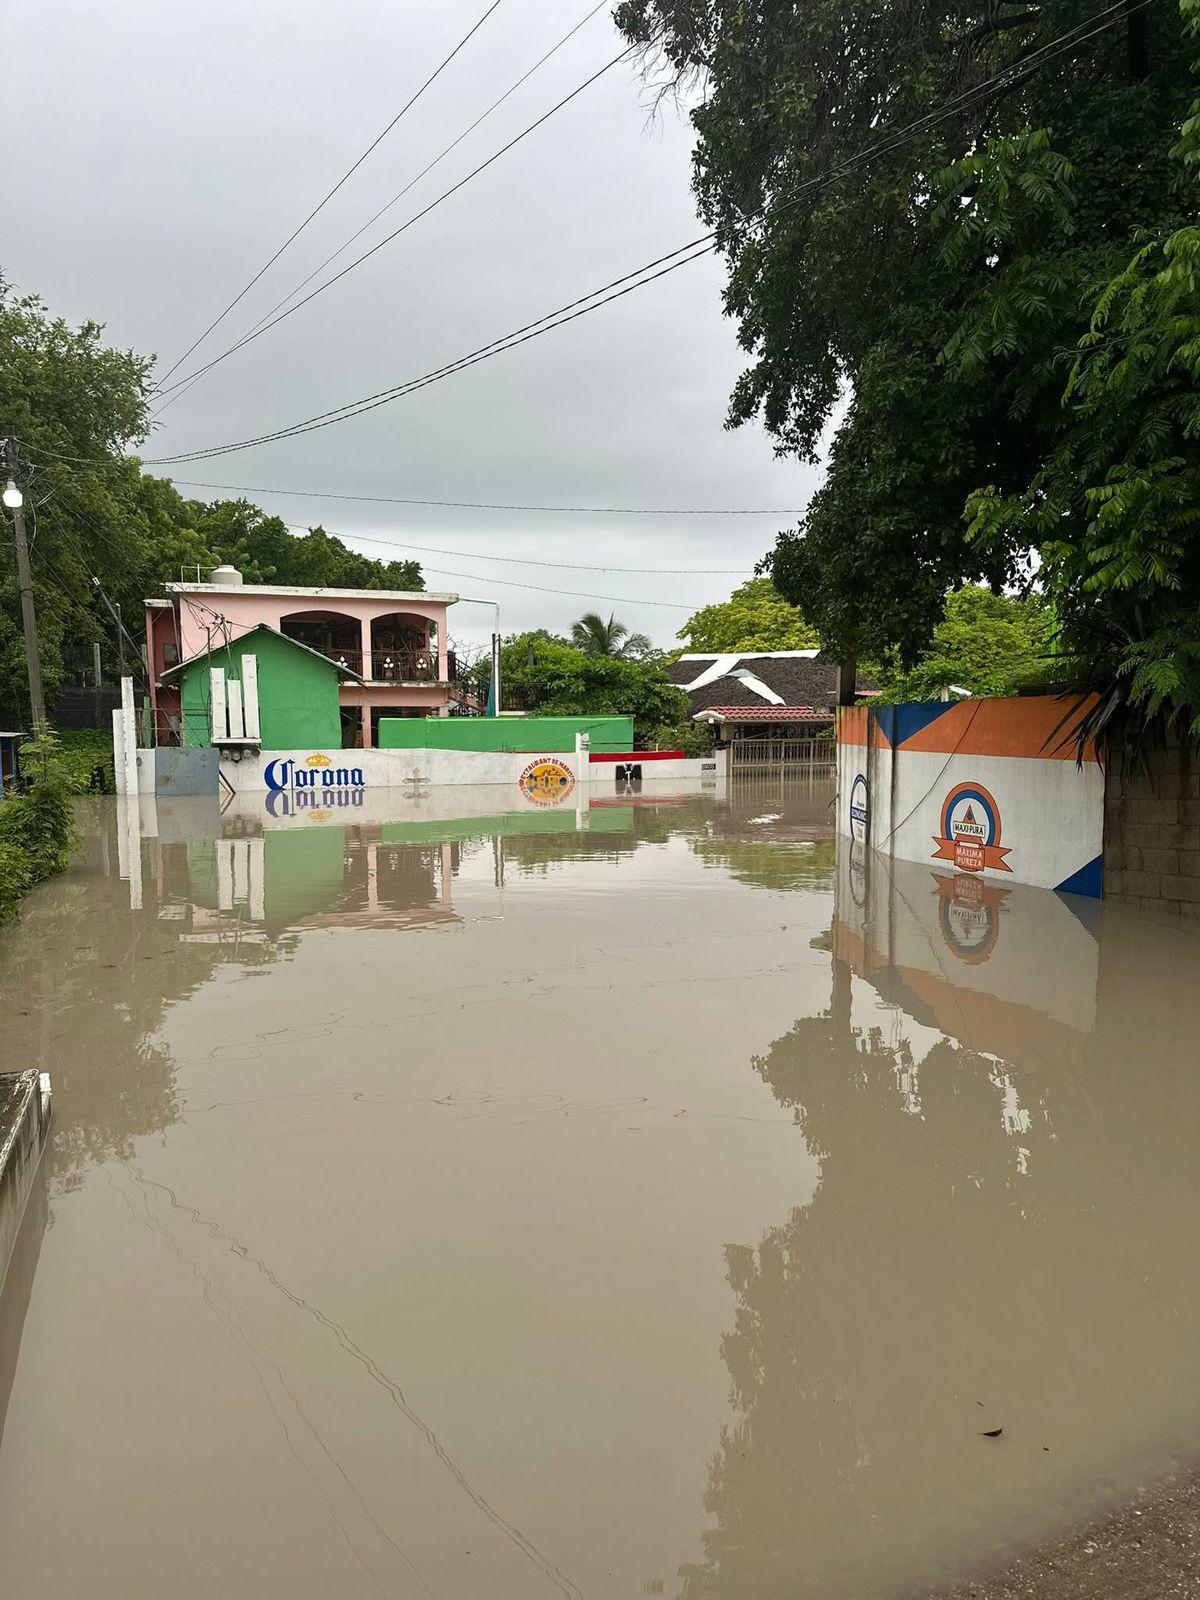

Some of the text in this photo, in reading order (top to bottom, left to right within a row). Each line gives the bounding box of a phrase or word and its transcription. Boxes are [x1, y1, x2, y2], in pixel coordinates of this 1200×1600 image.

[264, 758, 365, 791] Corona
[519, 758, 552, 783] RESTAURANT
[957, 857, 982, 868] PUREZA
